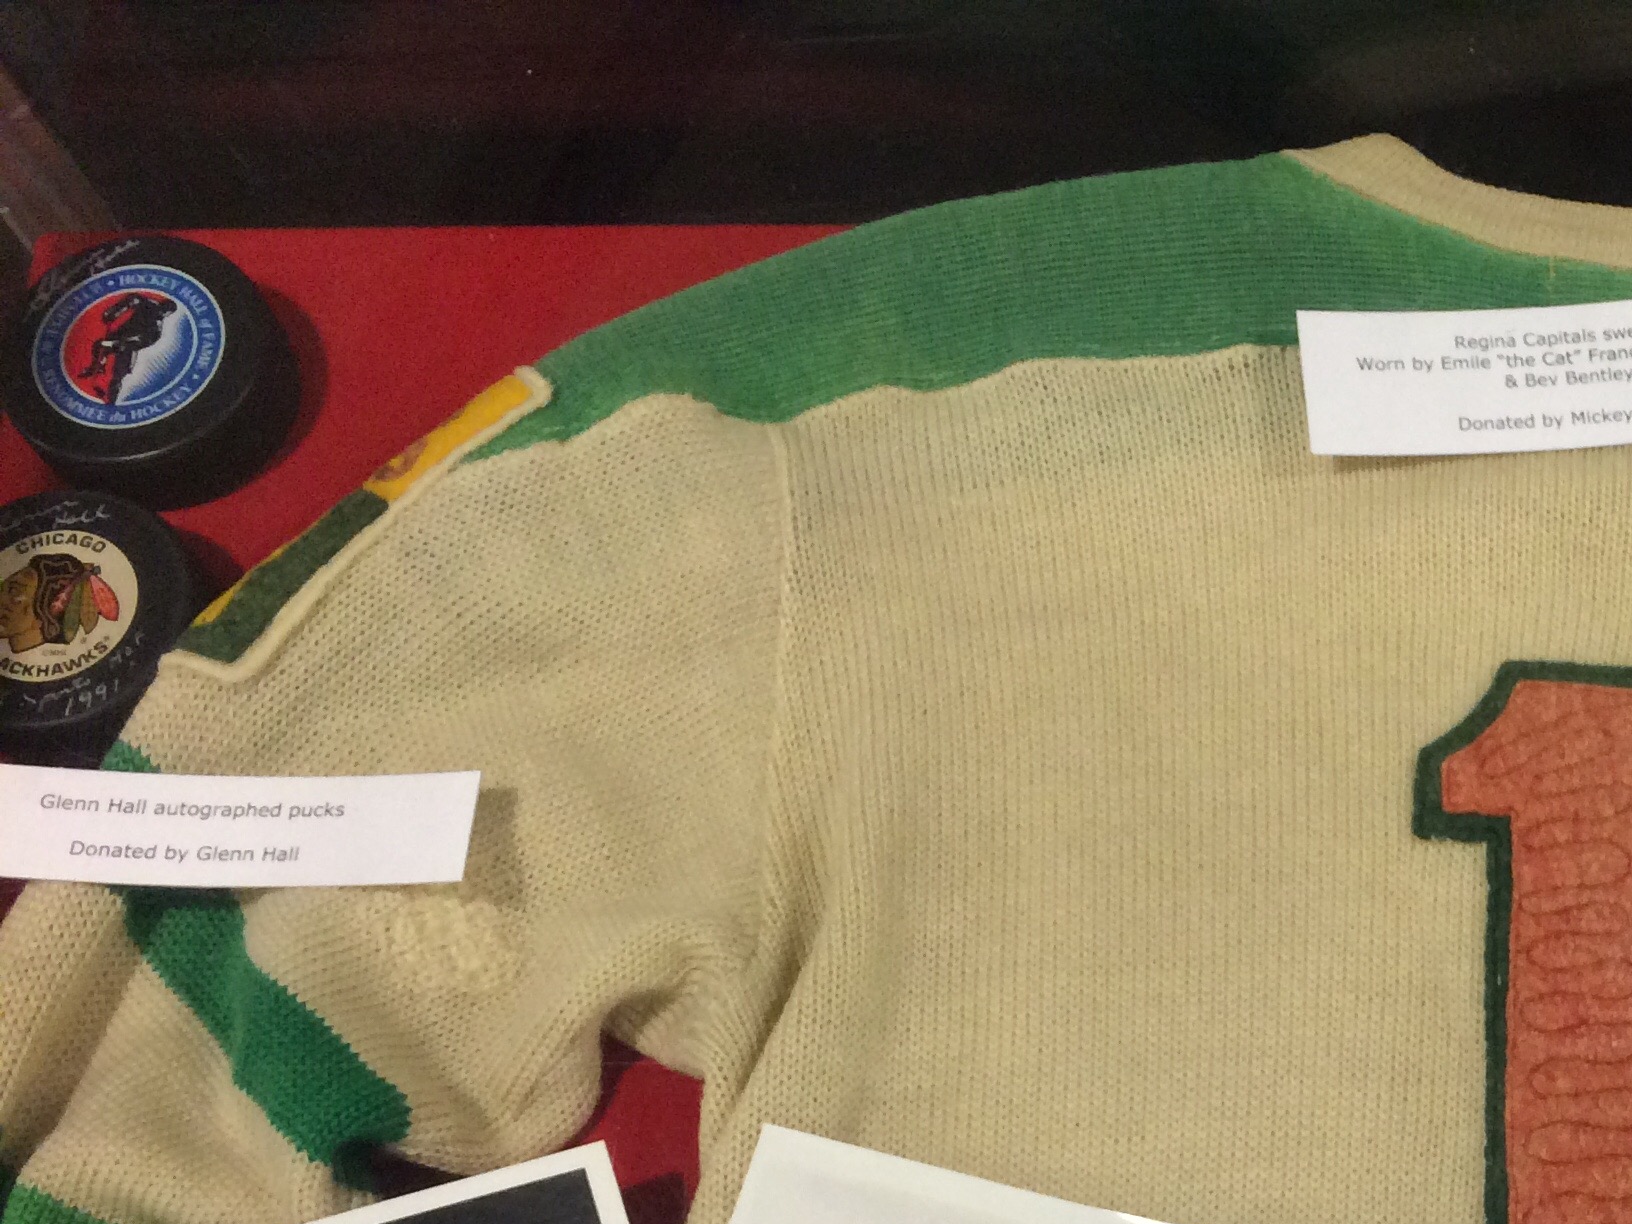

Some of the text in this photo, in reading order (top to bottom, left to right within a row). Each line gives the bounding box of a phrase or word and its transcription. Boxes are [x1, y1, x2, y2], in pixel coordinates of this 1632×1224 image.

[1455, 333, 1517, 353] Regina
[1523, 328, 1598, 349] Capitals
[1356, 354, 1406, 373] Worn
[1412, 353, 1434, 373] by
[1441, 352, 1492, 371] Emile
[1504, 374, 1518, 389] &
[1525, 370, 1560, 388] Bev
[1458, 412, 1536, 433] Donated
[1541, 410, 1564, 431] by
[1570, 404, 1632, 427] Mickey
[15, 532, 107, 554] CHICAGO
[0, 641, 109, 678] ACKHAWKS
[40, 794, 346, 821] Glenn Hall autographed pucks
[68, 839, 300, 864] Donated by Glenn Hall
